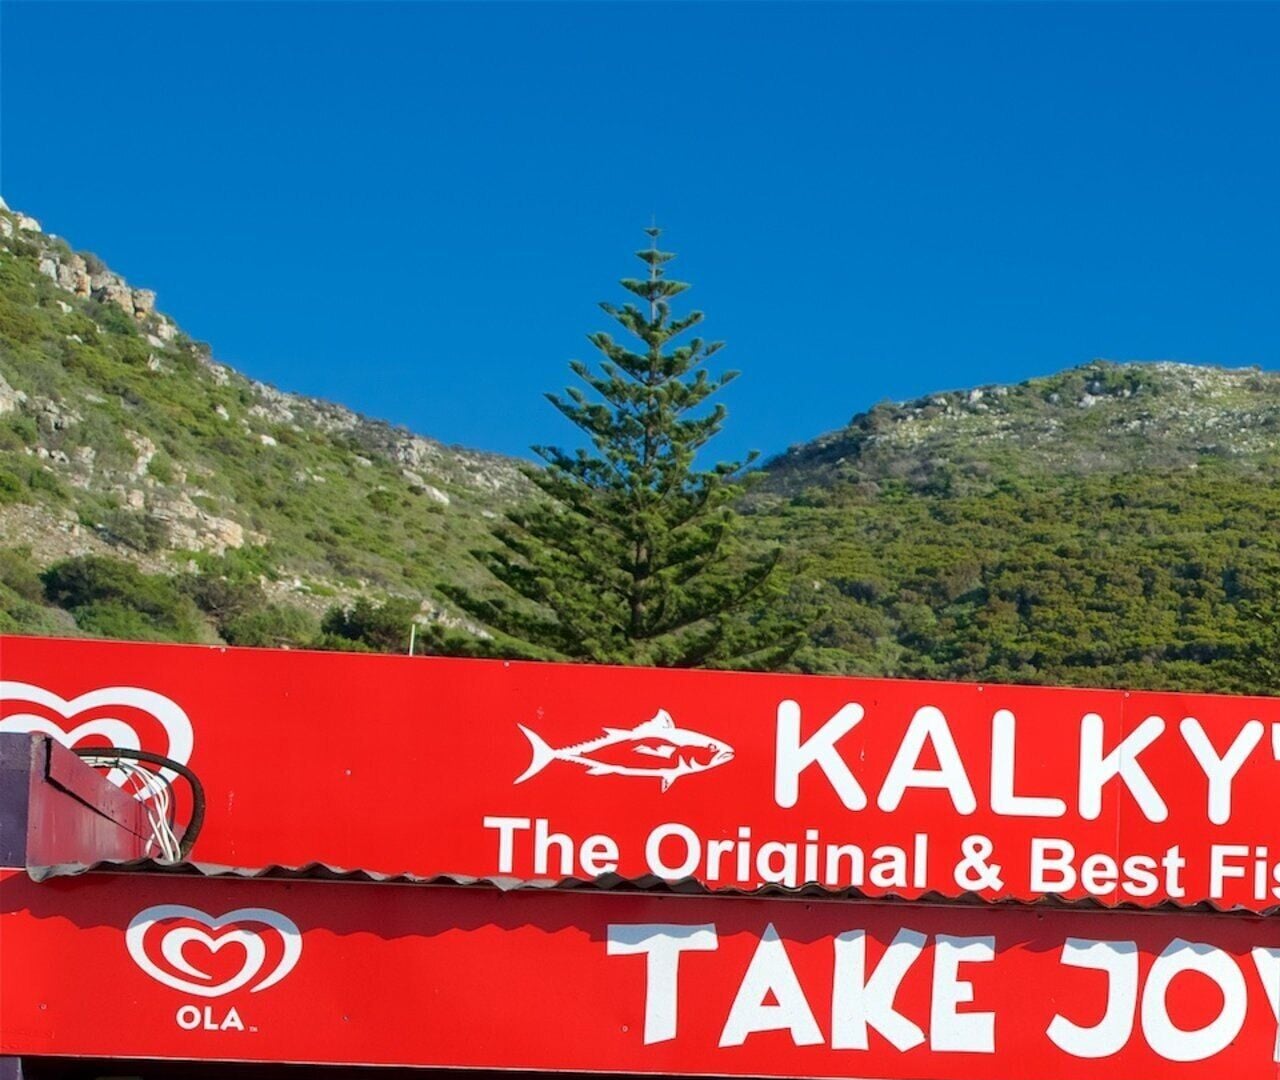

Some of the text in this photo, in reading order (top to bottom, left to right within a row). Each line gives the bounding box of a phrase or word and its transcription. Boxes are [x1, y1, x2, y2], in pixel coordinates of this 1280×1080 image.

[484, 817, 620, 878] The
[646, 823, 928, 889] Original
[954, 835, 1005, 892] &
[1030, 838, 1186, 897] Best
[176, 1005, 244, 1031] OLA
[607, 923, 996, 1054] TAKE
